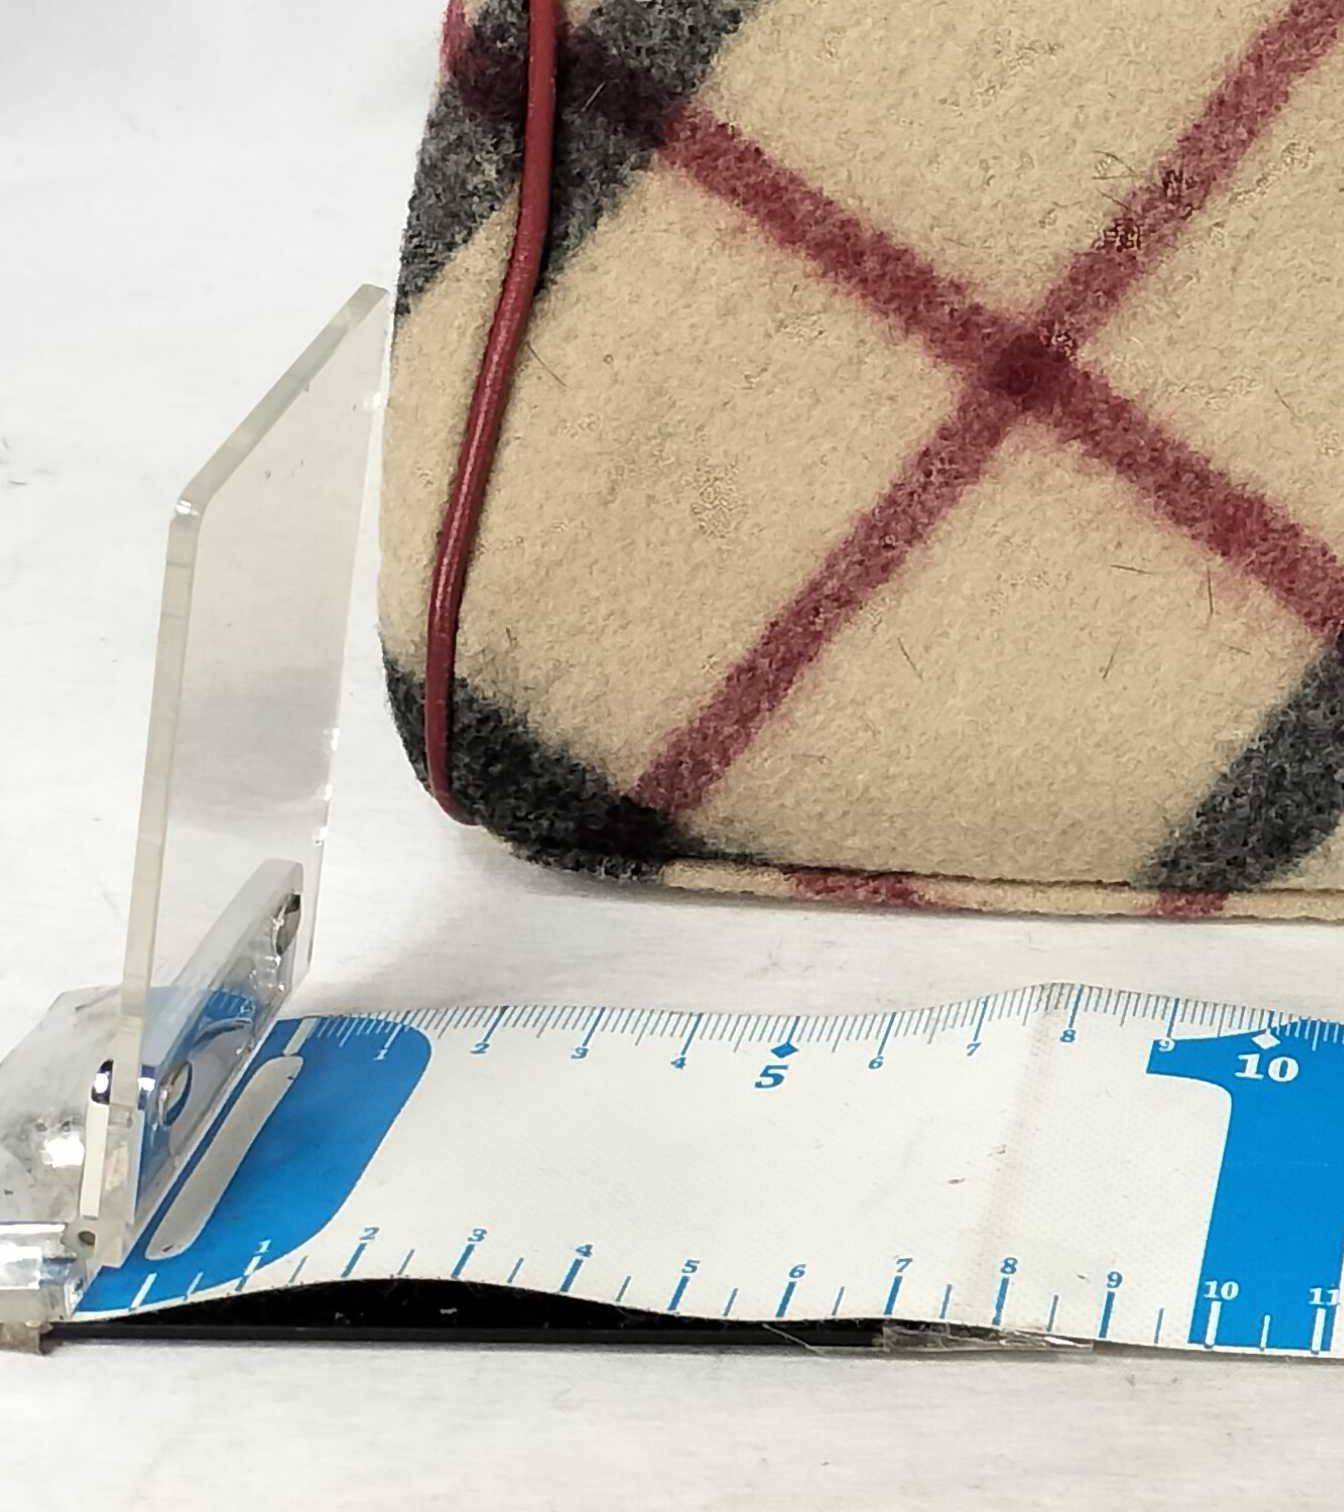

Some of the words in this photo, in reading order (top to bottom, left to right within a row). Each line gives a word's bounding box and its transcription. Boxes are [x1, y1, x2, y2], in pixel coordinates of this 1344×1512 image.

[373, 1049, 387, 1060] 1
[470, 1043, 490, 1054] 2
[571, 1047, 589, 1059] 3
[671, 1057, 686, 1069] 4
[755, 1065, 788, 1088] 5
[868, 1056, 884, 1070] 6
[967, 1044, 981, 1057] 7
[1060, 1030, 1076, 1043] 8
[1158, 1040, 1175, 1052] 9
[1235, 1053, 1300, 1082] 10
[254, 1240, 272, 1254] 1
[359, 1226, 380, 1241] 2
[467, 1228, 488, 1243] 3
[575, 1244, 593, 1258] 4
[681, 1259, 700, 1274] 5
[788, 1264, 806, 1279] 6
[896, 1258, 913, 1273] 7
[1000, 1257, 1018, 1275] 8
[1106, 1272, 1123, 1289] 9
[1203, 1281, 1239, 1300] 10
[1308, 1288, 1340, 1306] 11
